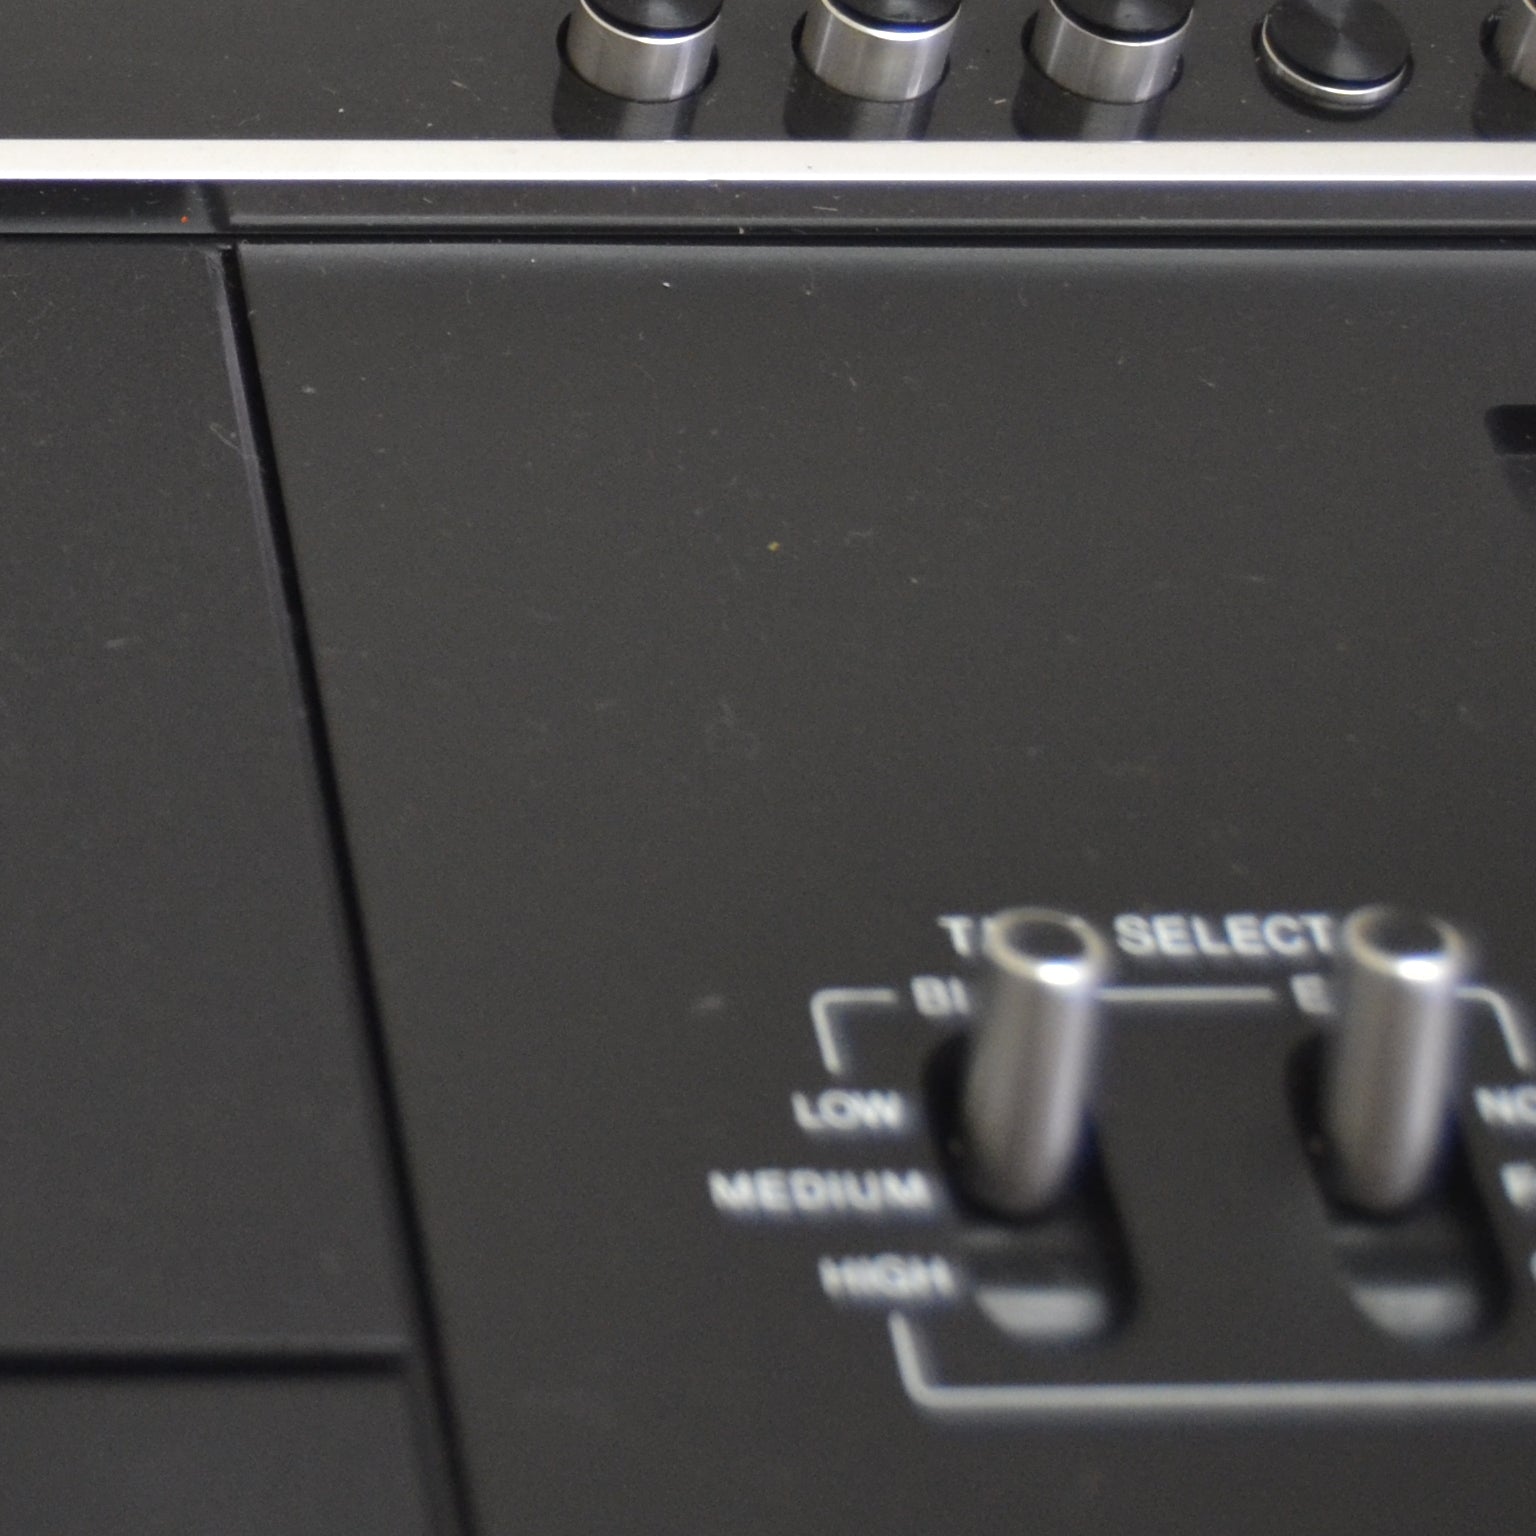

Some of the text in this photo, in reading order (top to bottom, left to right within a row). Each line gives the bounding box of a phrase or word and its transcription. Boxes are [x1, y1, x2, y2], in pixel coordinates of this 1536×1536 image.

[790, 1088, 904, 1132] LOW
[708, 1167, 931, 1212] MEDIUM
[818, 1252, 955, 1300] HIGH
